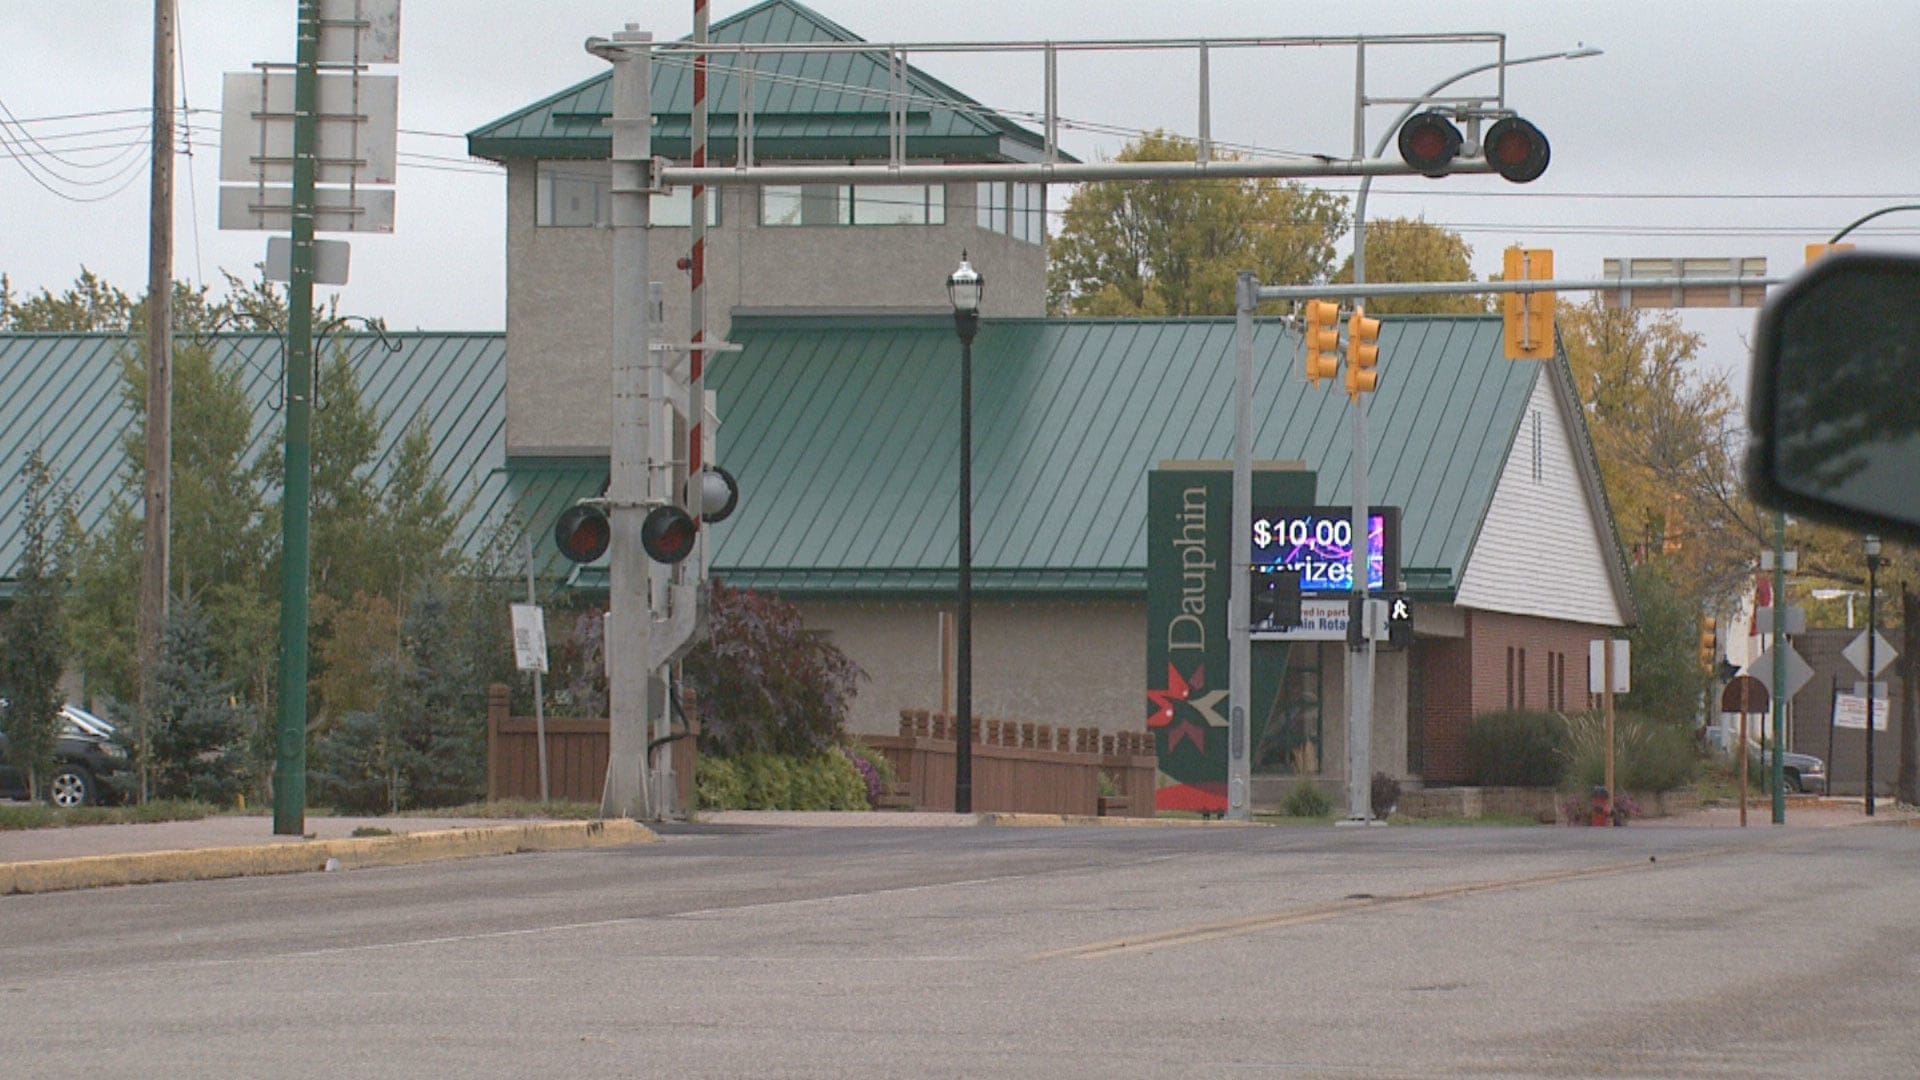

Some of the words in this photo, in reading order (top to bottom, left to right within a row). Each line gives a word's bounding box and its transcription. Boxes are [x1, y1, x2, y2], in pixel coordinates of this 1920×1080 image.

[1253, 519, 1352, 550] $10,00
[1168, 485, 1217, 653] Dauphin
[1319, 617, 1346, 630] Rota
[1327, 607, 1346, 618] part
